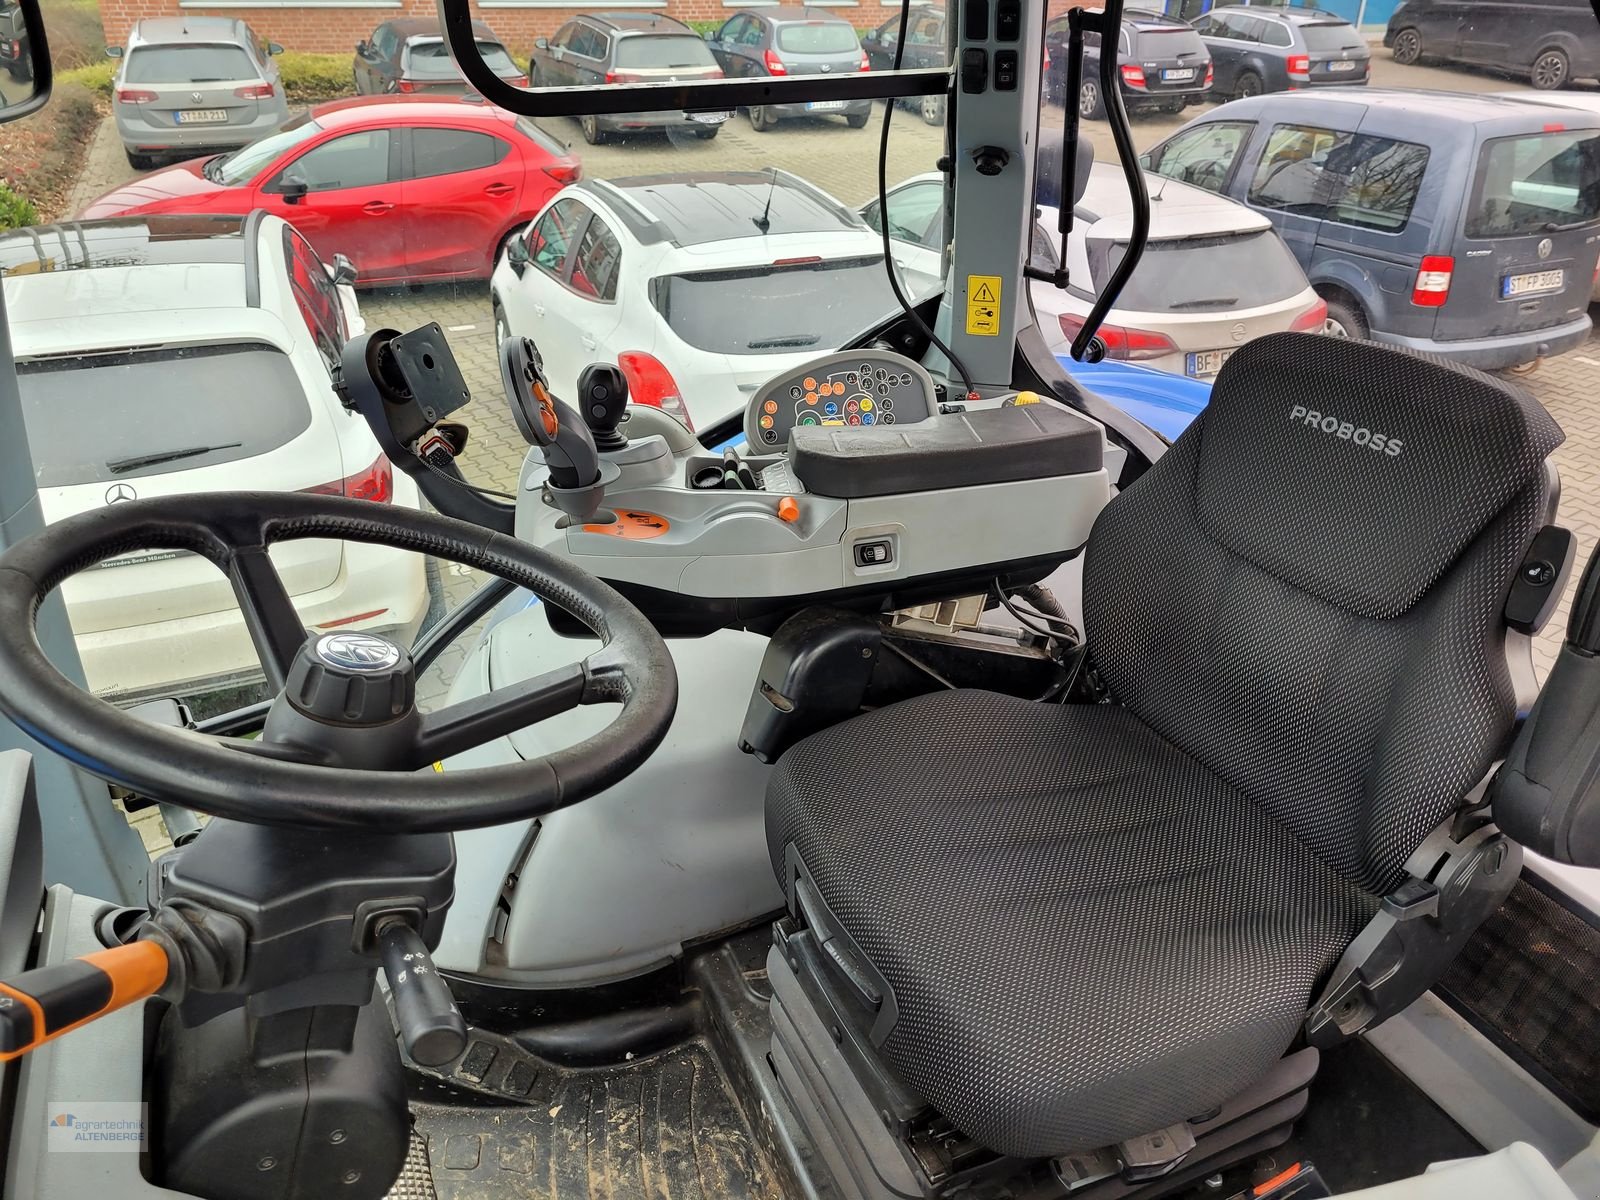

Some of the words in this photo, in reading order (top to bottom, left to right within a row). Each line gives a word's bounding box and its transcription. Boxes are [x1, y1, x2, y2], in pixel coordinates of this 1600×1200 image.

[1511, 277, 1522, 292] ST
[1196, 354, 1211, 371] BF
[1290, 405, 1403, 456] PROBOSS
[147, 552, 176, 562] München
